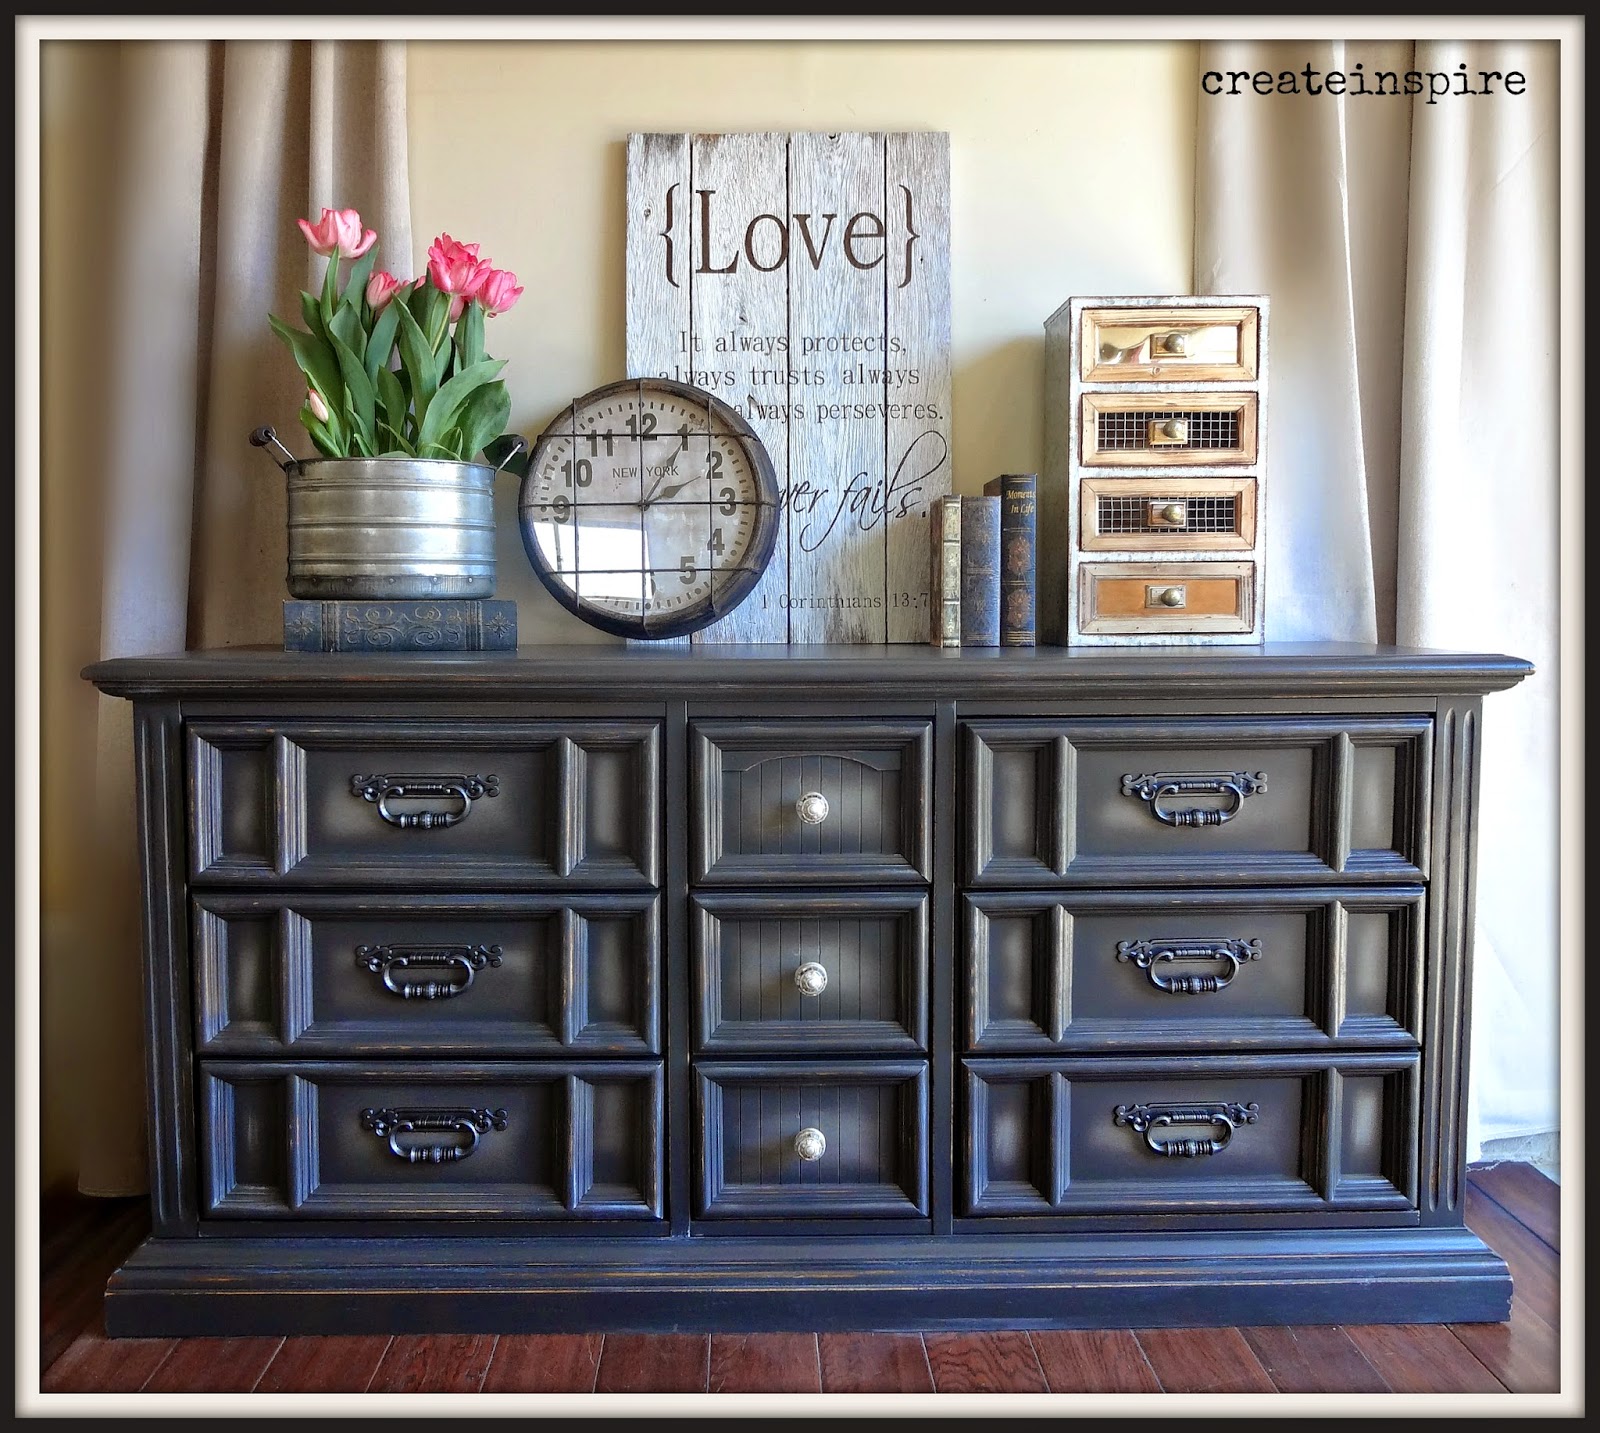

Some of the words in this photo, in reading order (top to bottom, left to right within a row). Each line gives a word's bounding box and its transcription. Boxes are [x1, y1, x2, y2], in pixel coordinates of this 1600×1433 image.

[681, 331, 702, 353] It
[715, 331, 789, 356] always
[802, 332, 907, 356] protects,
[748, 365, 825, 386] trusts
[843, 364, 920, 389] always
[817, 402, 944, 424] perseveres.
[625, 413, 658, 442] 12
[586, 428, 614, 457] 11
[560, 458, 593, 488] 10
[612, 467, 637, 478] NEW
[646, 466, 679, 477] YORK
[705, 451, 723, 480] 2
[719, 488, 736, 516] 3
[778, 480, 828, 514] ver
[800, 430, 947, 552] fails.
[552, 494, 571, 524] 9
[707, 528, 725, 556] 4
[680, 556, 697, 584] 5
[779, 593, 882, 609] Corinthians
